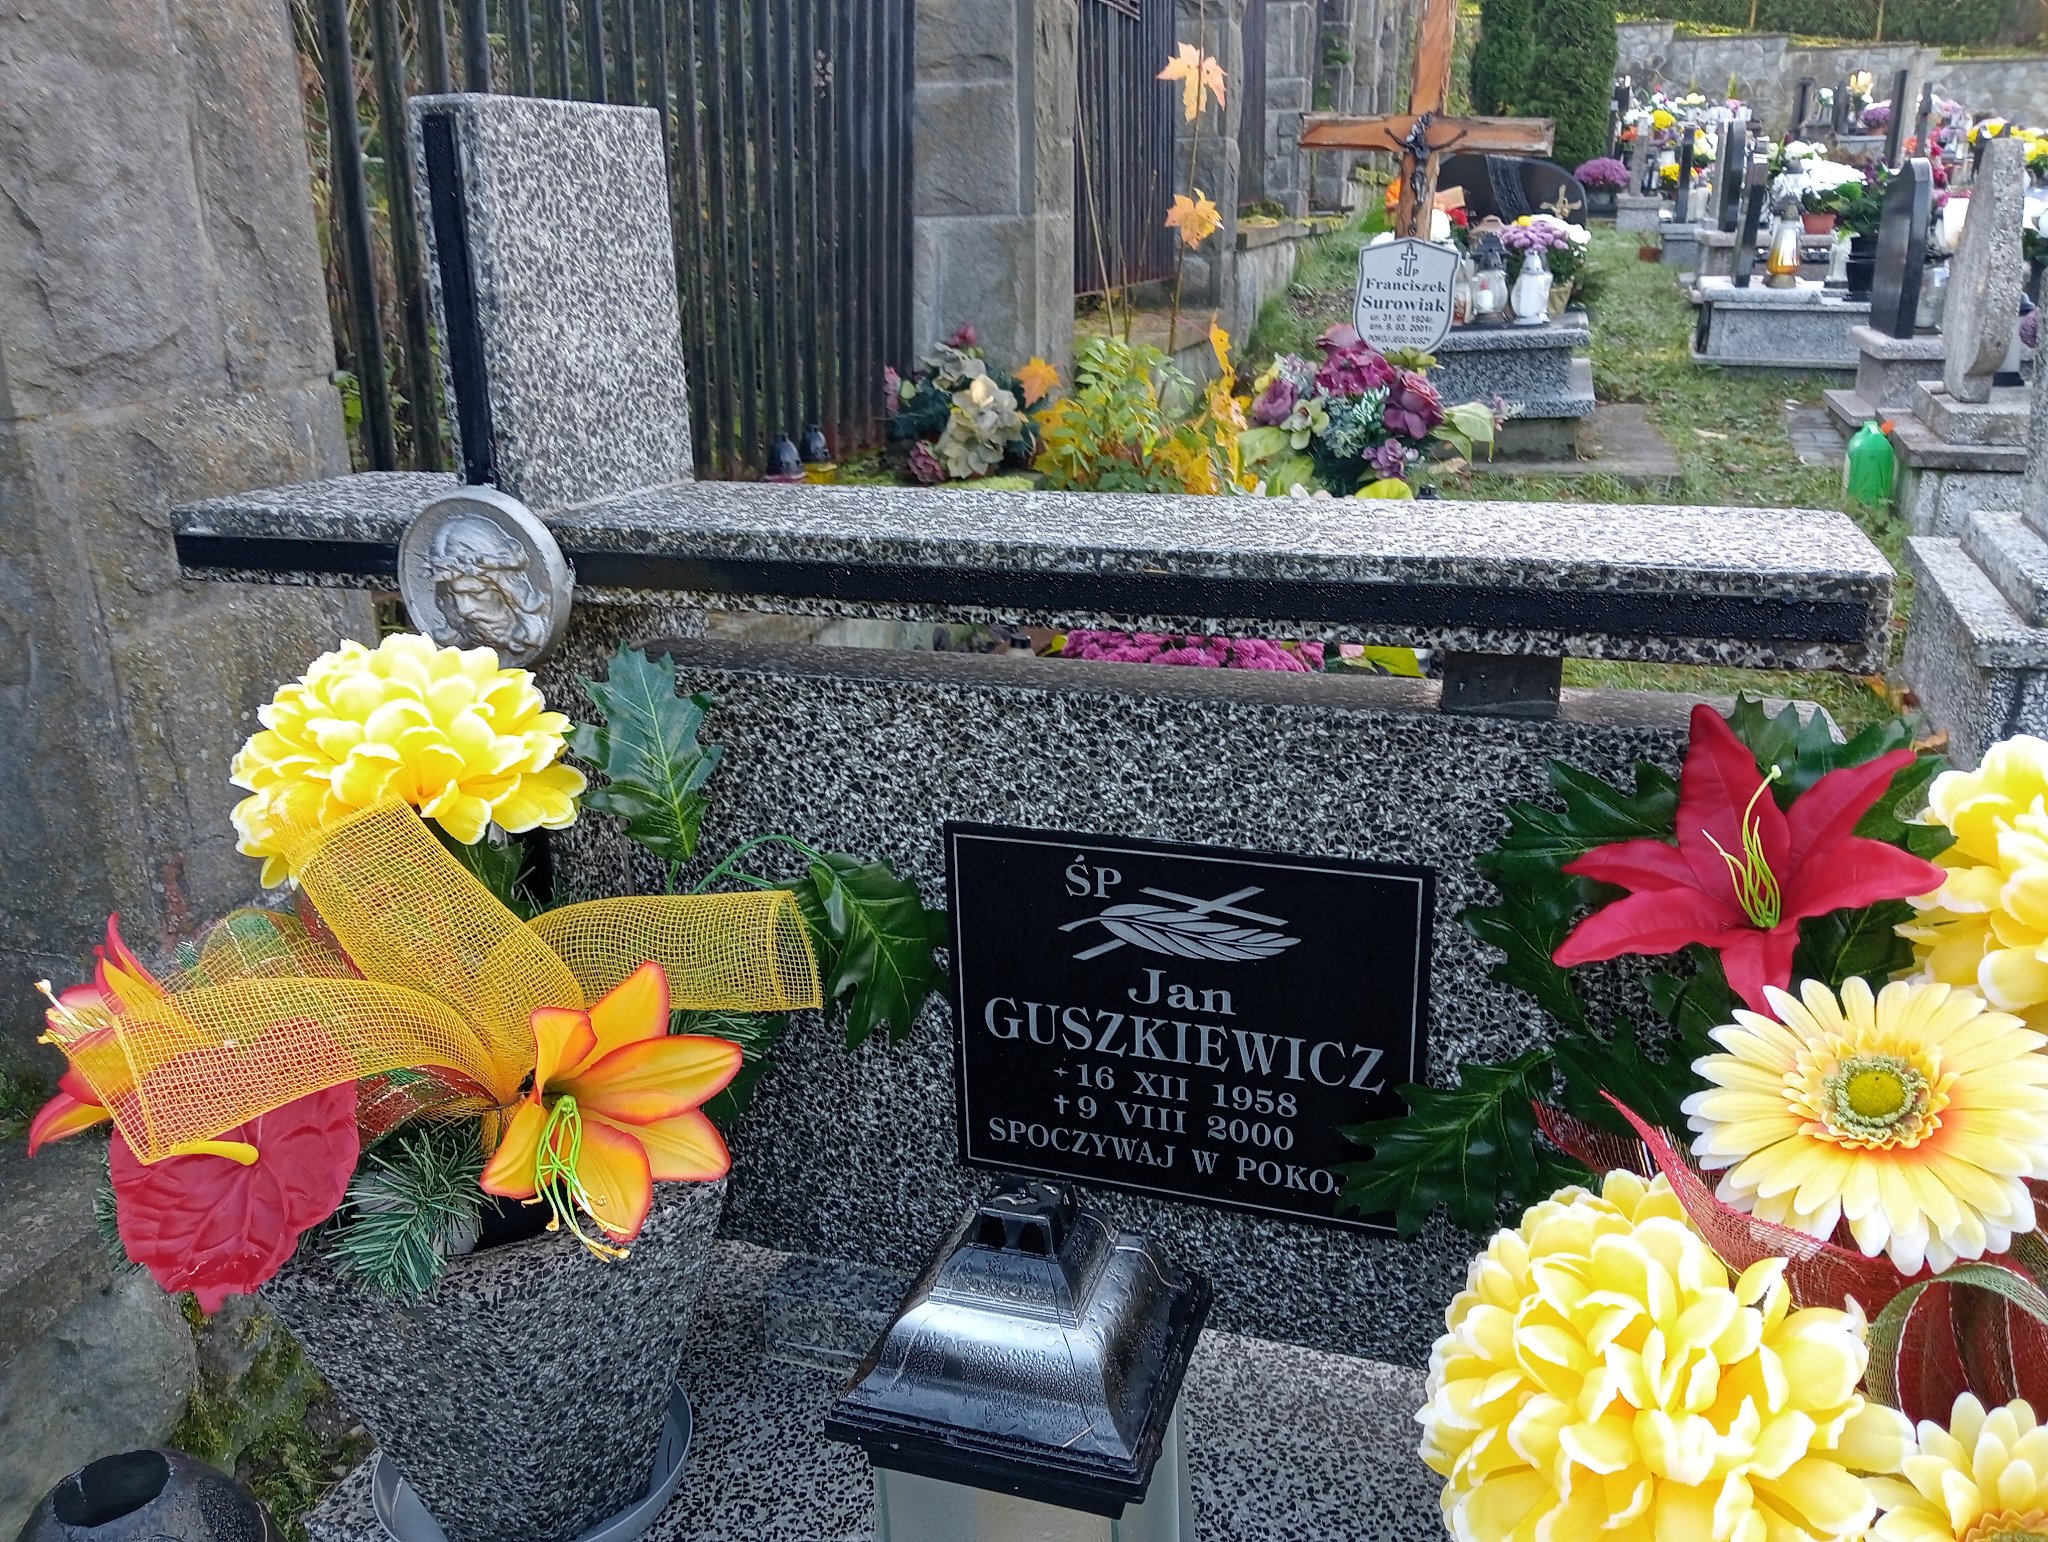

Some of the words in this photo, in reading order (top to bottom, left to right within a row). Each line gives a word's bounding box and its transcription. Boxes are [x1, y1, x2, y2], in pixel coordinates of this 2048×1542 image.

[1361, 295, 1446, 312] Surowiak
[1366, 278, 1447, 293] Franciszek
[1065, 854, 1122, 899] ŚP
[1127, 968, 1237, 1016] Jan
[984, 997, 1386, 1096] GUSZKIEWICZ
[1132, 1070, 1190, 1102] XII
[1212, 1083, 1298, 1118] 1958
[1114, 1100, 1187, 1134] VIII
[1207, 1115, 1294, 1151] 2000
[989, 1117, 1176, 1169] SPOCZYWAJ
[1191, 1149, 1219, 1175] W
[1236, 1156, 1343, 1197] POKO
